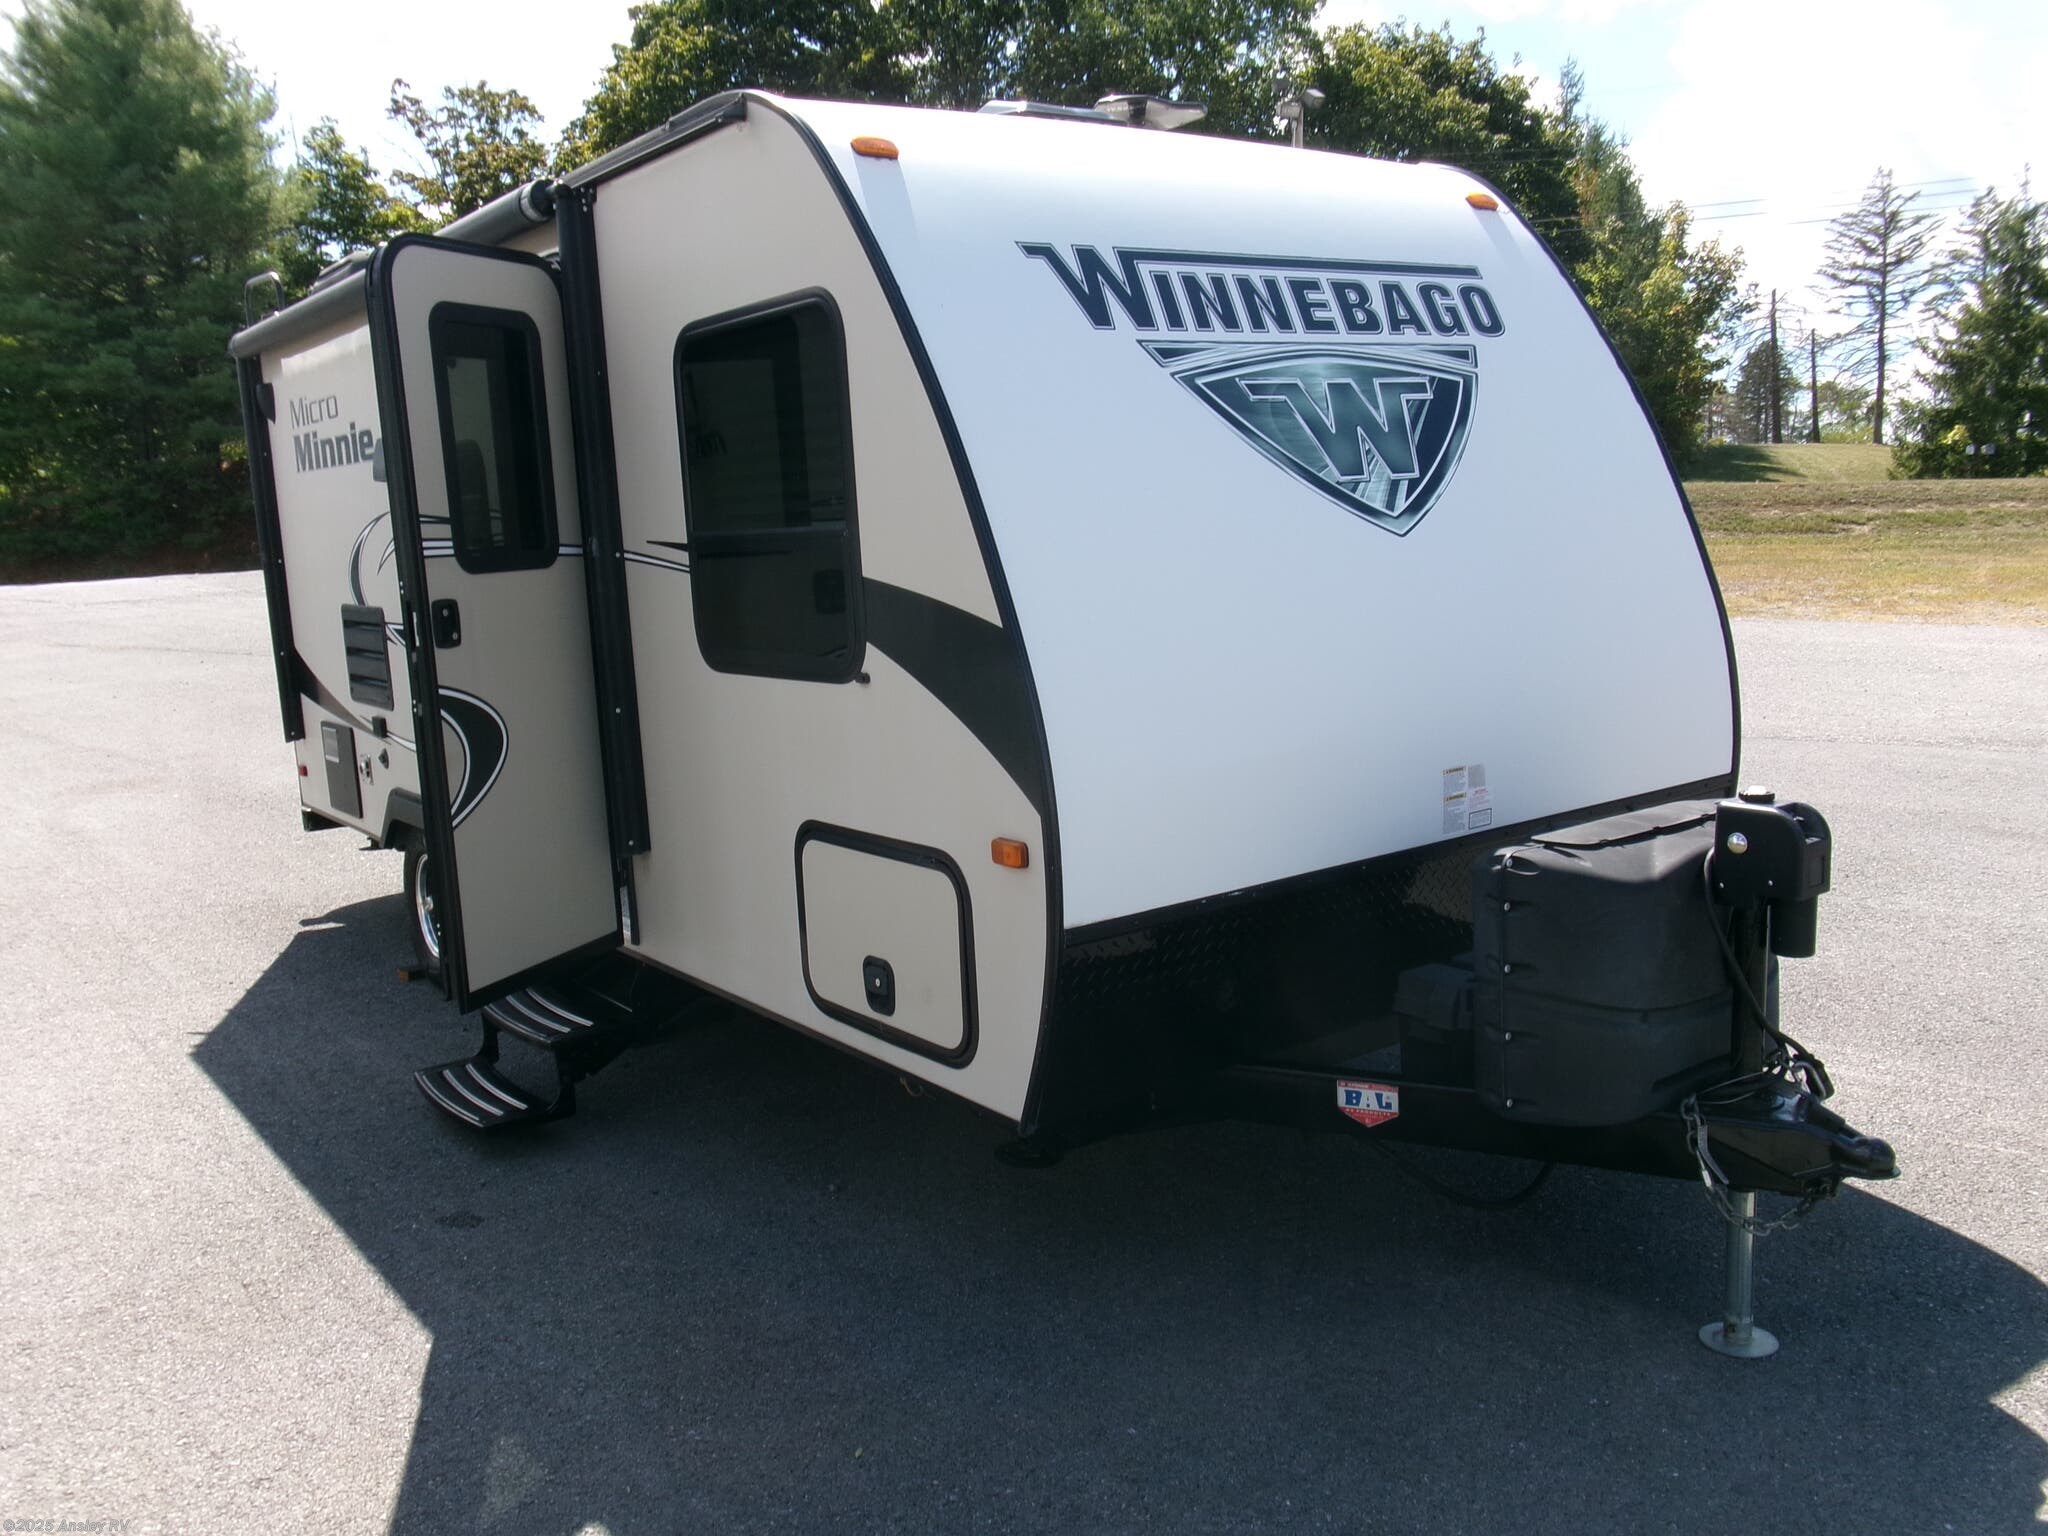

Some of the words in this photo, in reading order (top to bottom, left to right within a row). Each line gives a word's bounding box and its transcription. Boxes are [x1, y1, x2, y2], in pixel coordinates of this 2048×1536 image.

[1014, 240, 1506, 338] WINNEBAGO
[289, 395, 339, 428] Micro
[293, 421, 375, 472] Minnie
[1234, 377, 1435, 482] W
